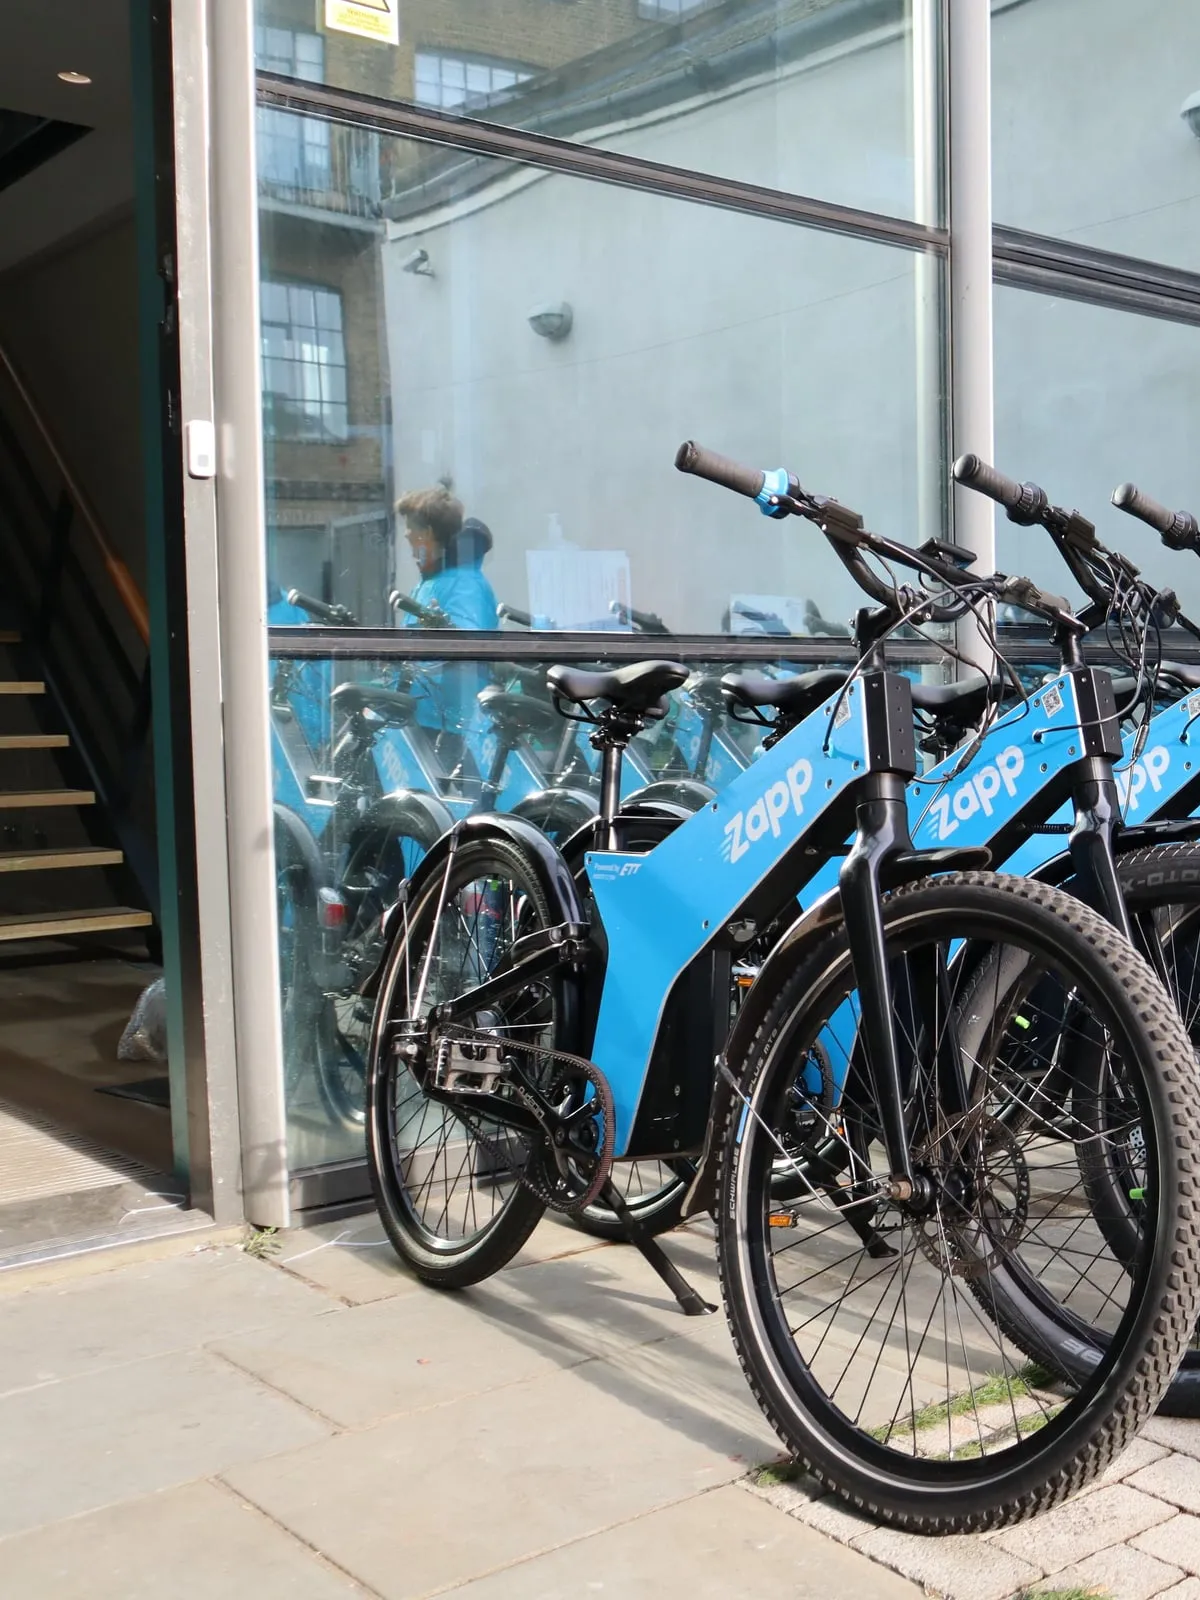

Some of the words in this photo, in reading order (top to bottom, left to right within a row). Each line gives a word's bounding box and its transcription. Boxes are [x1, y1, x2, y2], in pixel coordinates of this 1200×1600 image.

[719, 758, 813, 864] zapp
[926, 745, 1024, 841] zapp
[729, 1146, 740, 1220] SCHWALBE
